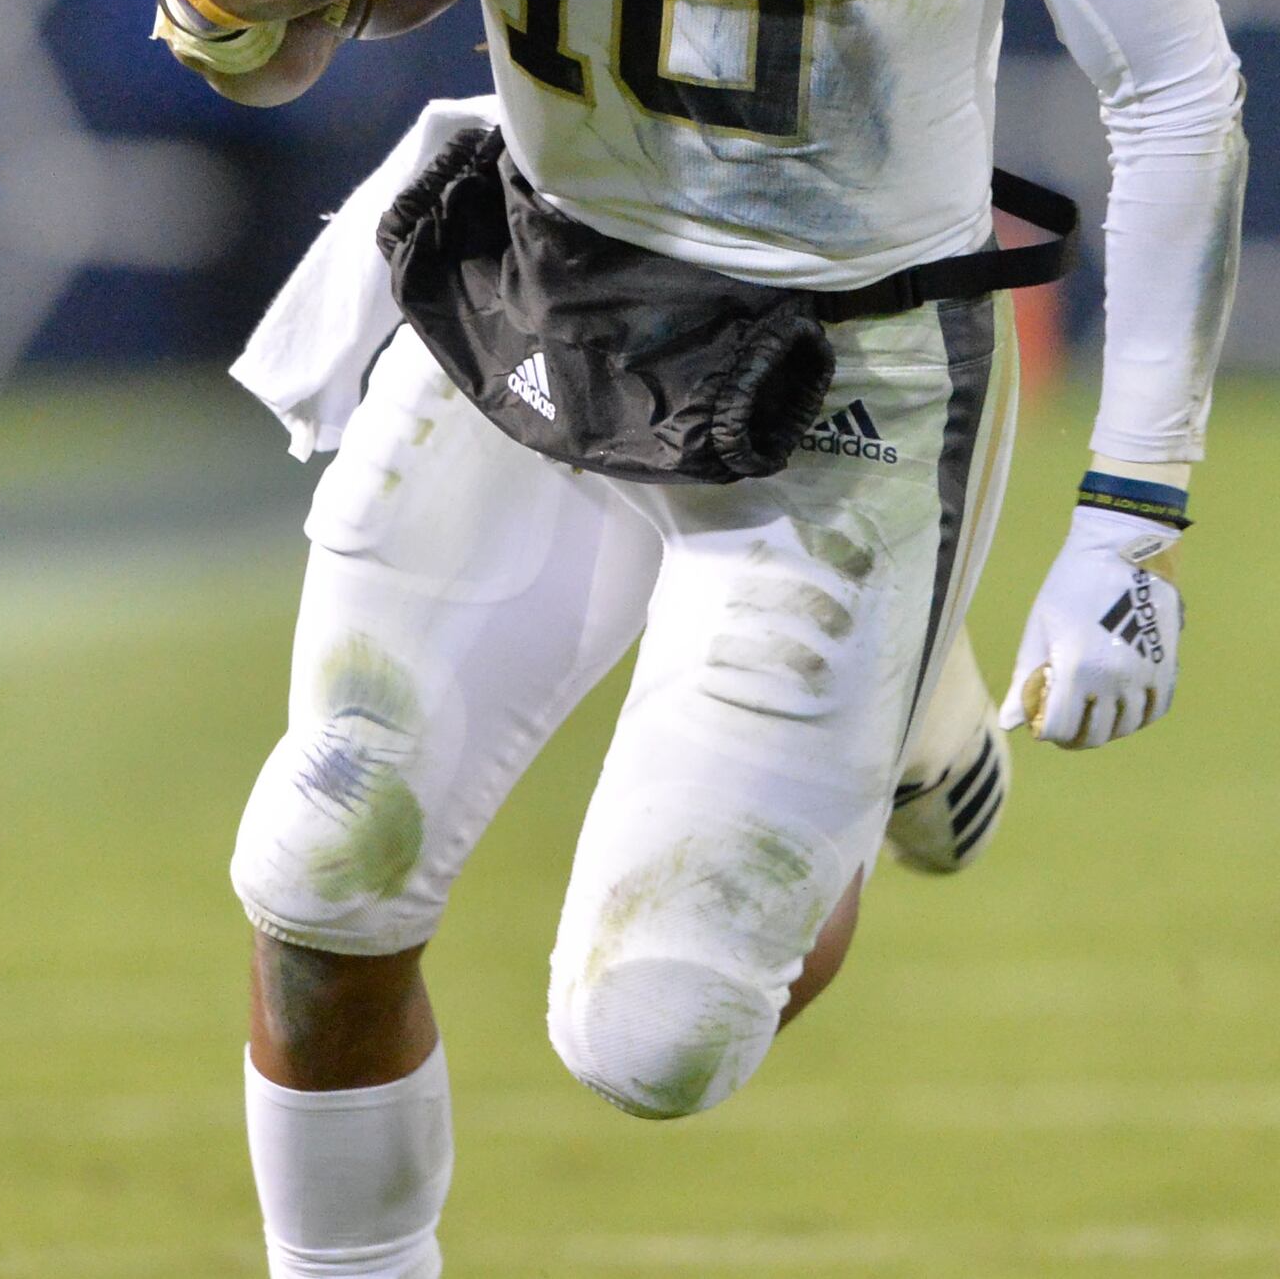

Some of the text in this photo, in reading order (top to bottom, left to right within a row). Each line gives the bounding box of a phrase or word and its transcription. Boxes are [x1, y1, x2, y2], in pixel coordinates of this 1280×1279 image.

[507, 373, 556, 421] adidas
[800, 430, 898, 465] adidas
[1132, 568, 1166, 665] adidas
